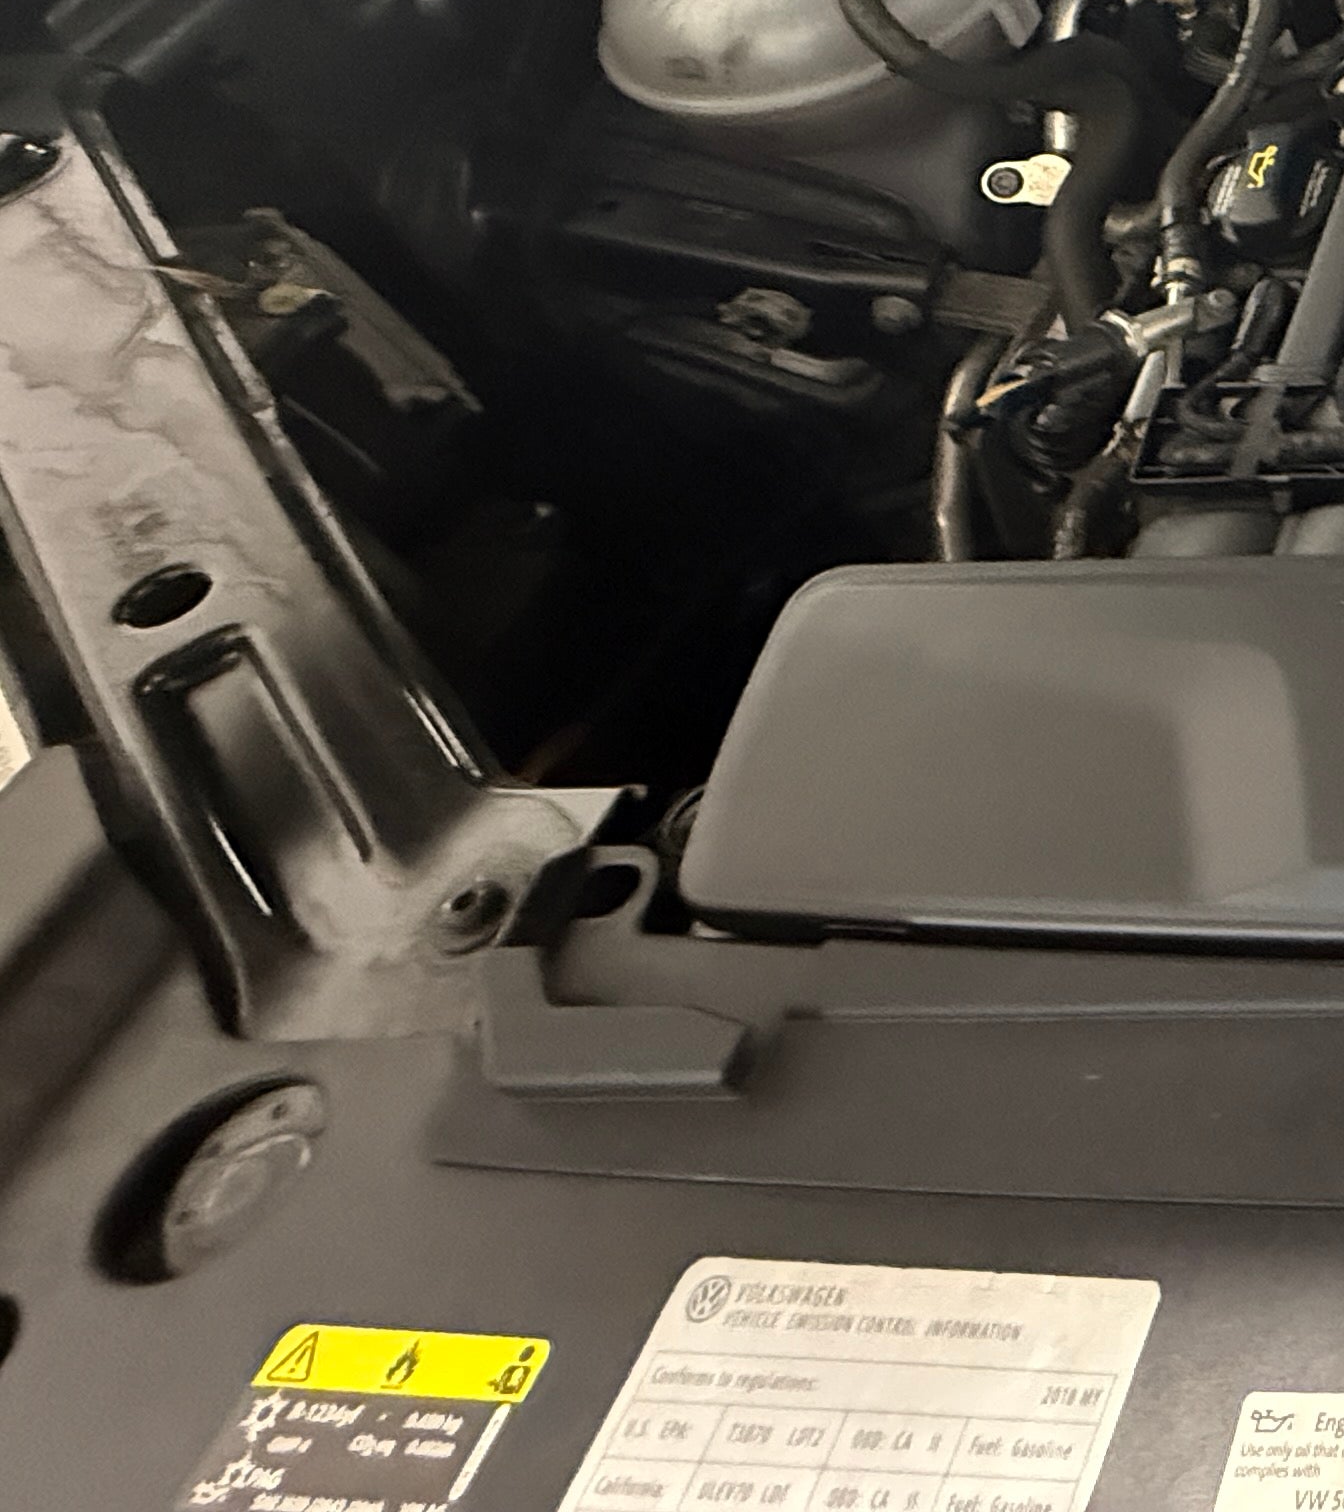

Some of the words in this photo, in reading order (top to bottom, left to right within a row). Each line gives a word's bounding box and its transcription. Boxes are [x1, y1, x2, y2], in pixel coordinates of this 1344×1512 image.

[734, 1283, 850, 1307] VOLKSWAGEN
[925, 1318, 1023, 1341] INFORMATION
[1010, 1437, 1073, 1461] Gasoline
[1240, 1442, 1265, 1458] Use
[1265, 1443, 1293, 1462] only
[1313, 1443, 1340, 1458] that
[1292, 1462, 1321, 1478] with
[1294, 1489, 1330, 1511] VW
